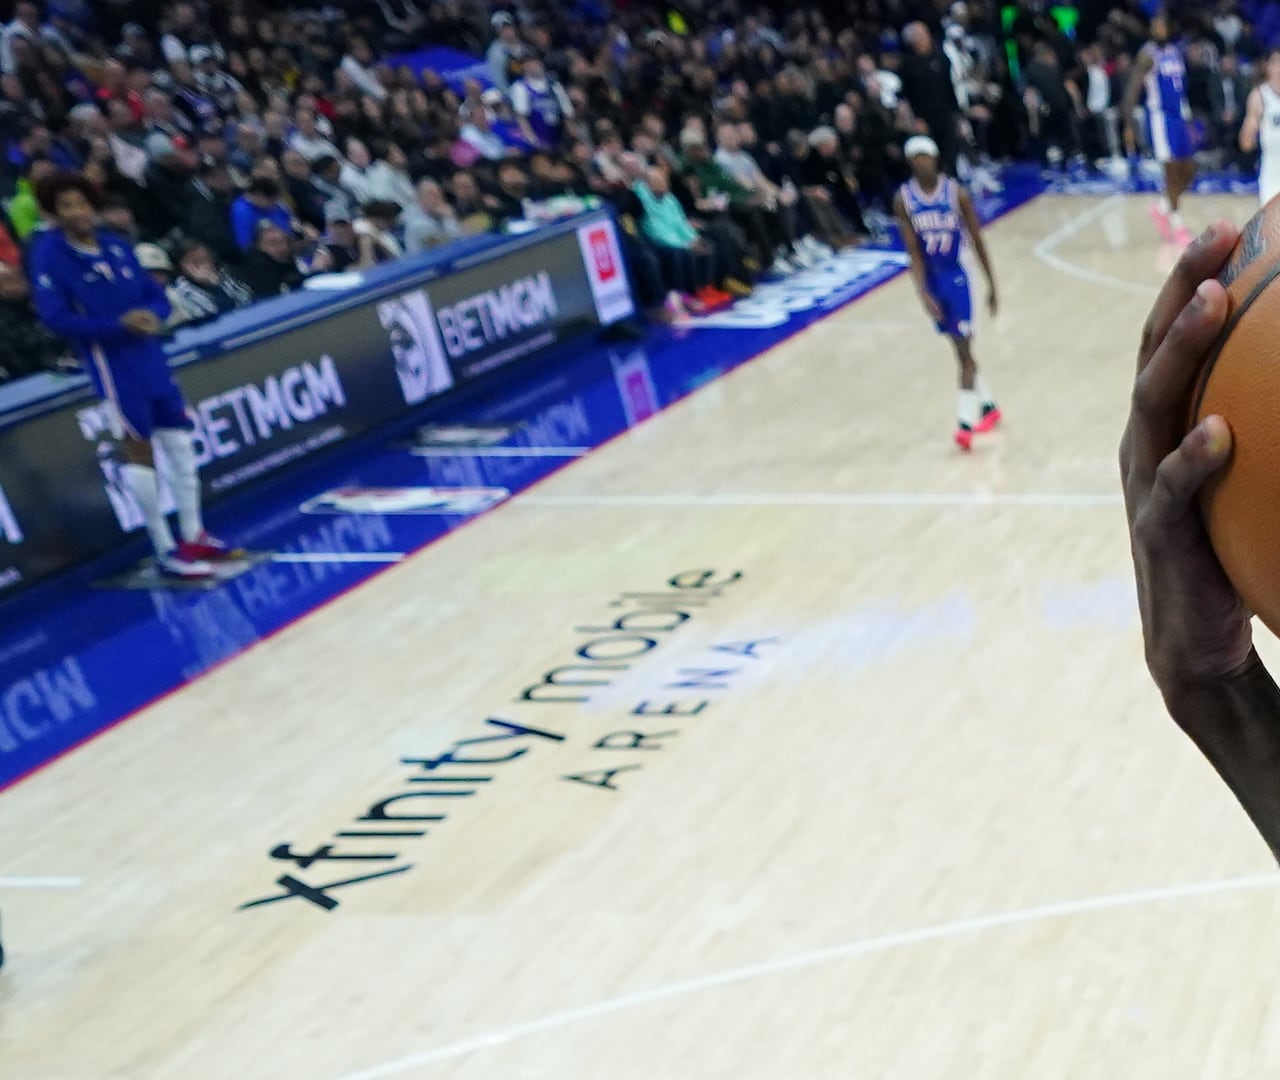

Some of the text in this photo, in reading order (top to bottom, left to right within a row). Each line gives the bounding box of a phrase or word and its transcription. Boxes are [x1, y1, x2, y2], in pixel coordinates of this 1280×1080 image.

[436, 271, 557, 359] BETMGM
[236, 569, 744, 912] xfinity mobile
[558, 636, 779, 791] ARENA
